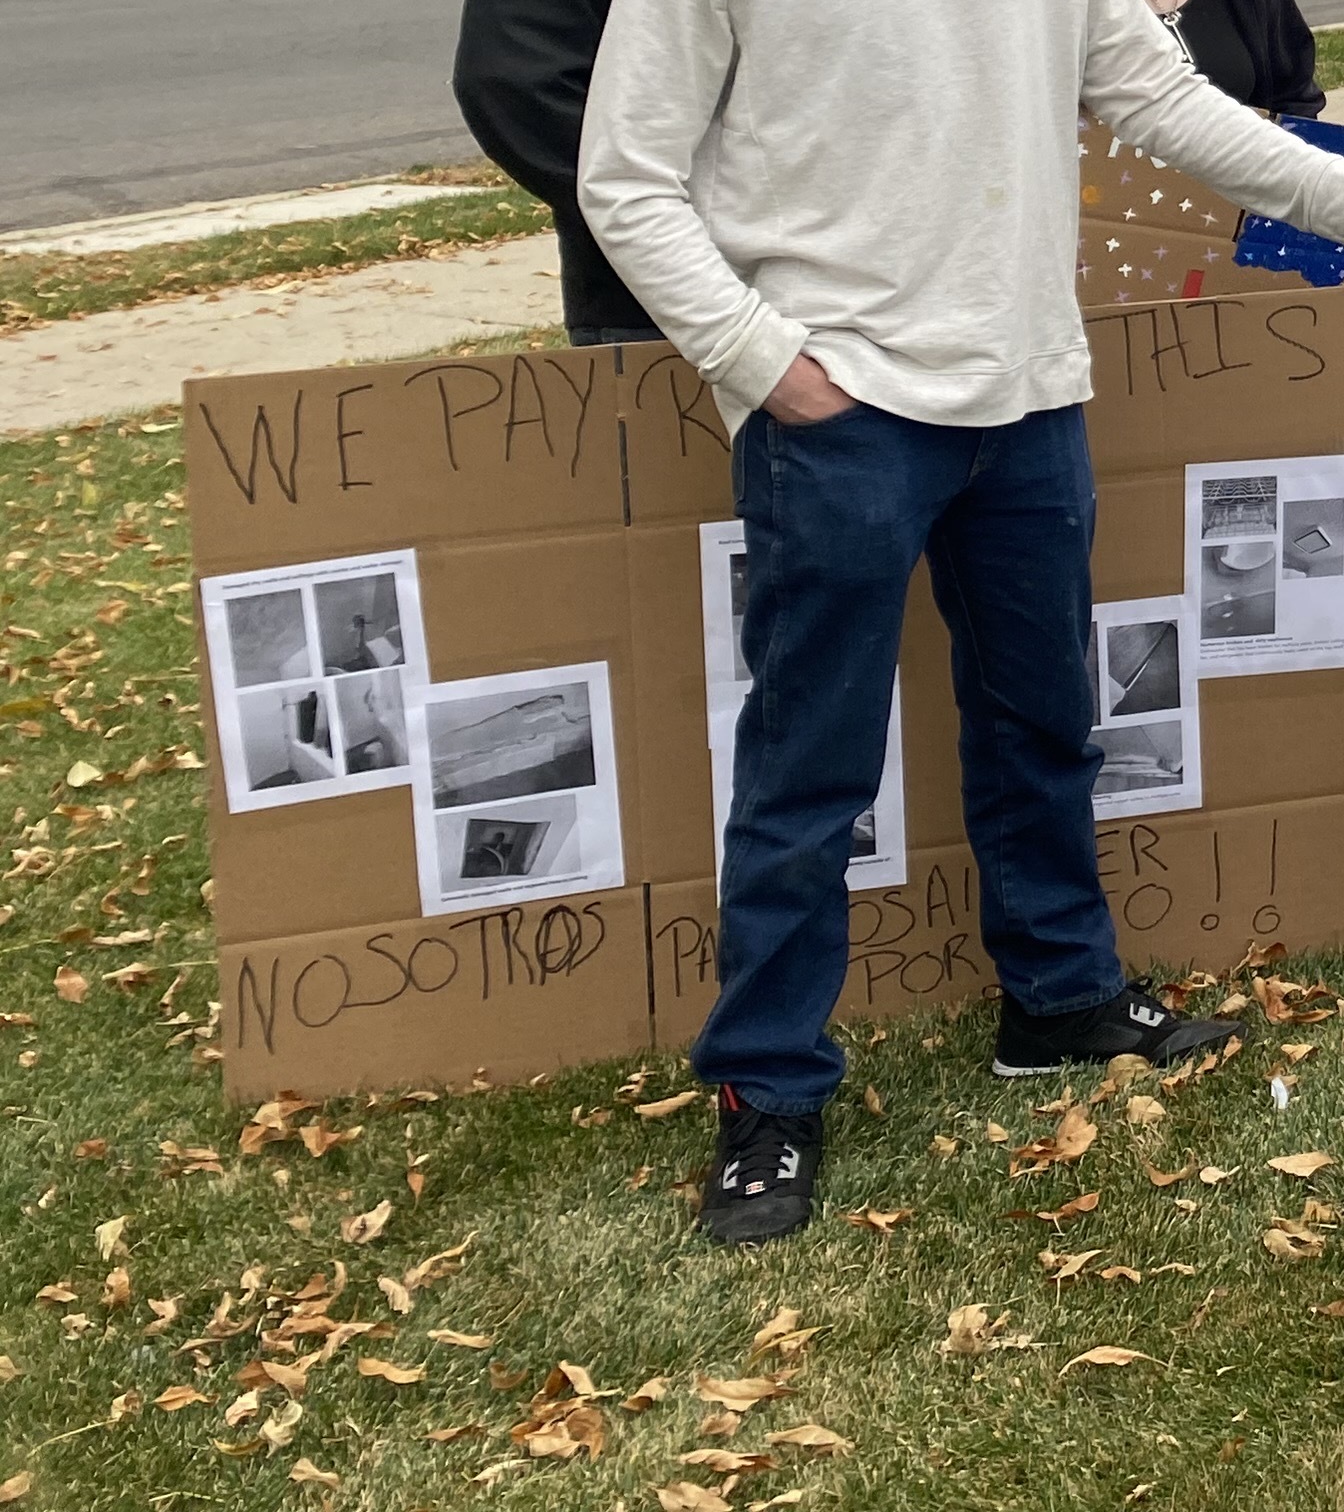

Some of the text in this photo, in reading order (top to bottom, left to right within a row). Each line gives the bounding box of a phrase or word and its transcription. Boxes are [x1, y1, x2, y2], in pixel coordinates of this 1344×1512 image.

[199, 383, 374, 505] WE
[404, 354, 595, 478] PAY
[1086, 300, 1326, 396] THIS
[847, 933, 979, 1005] POR
